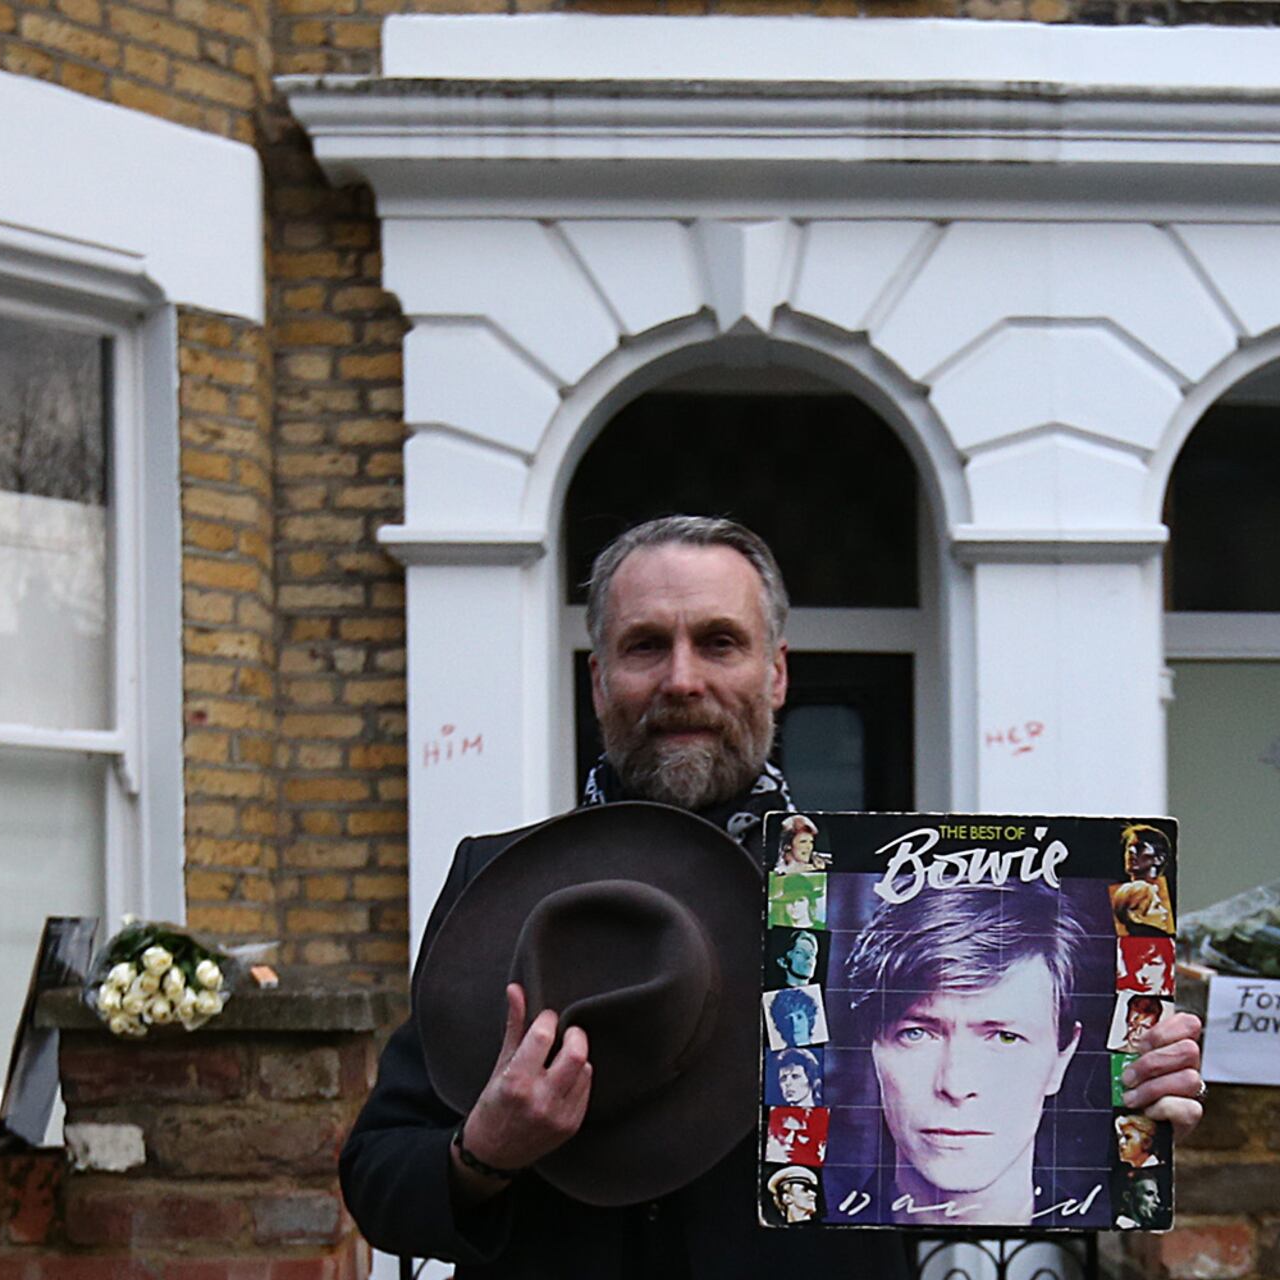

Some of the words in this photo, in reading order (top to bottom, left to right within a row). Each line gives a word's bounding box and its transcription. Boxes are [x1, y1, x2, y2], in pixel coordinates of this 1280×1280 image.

[939, 825, 967, 839] THE
[969, 826, 1003, 840] BEST
[1004, 826, 1026, 840] OF
[873, 826, 1069, 905] Bowie
